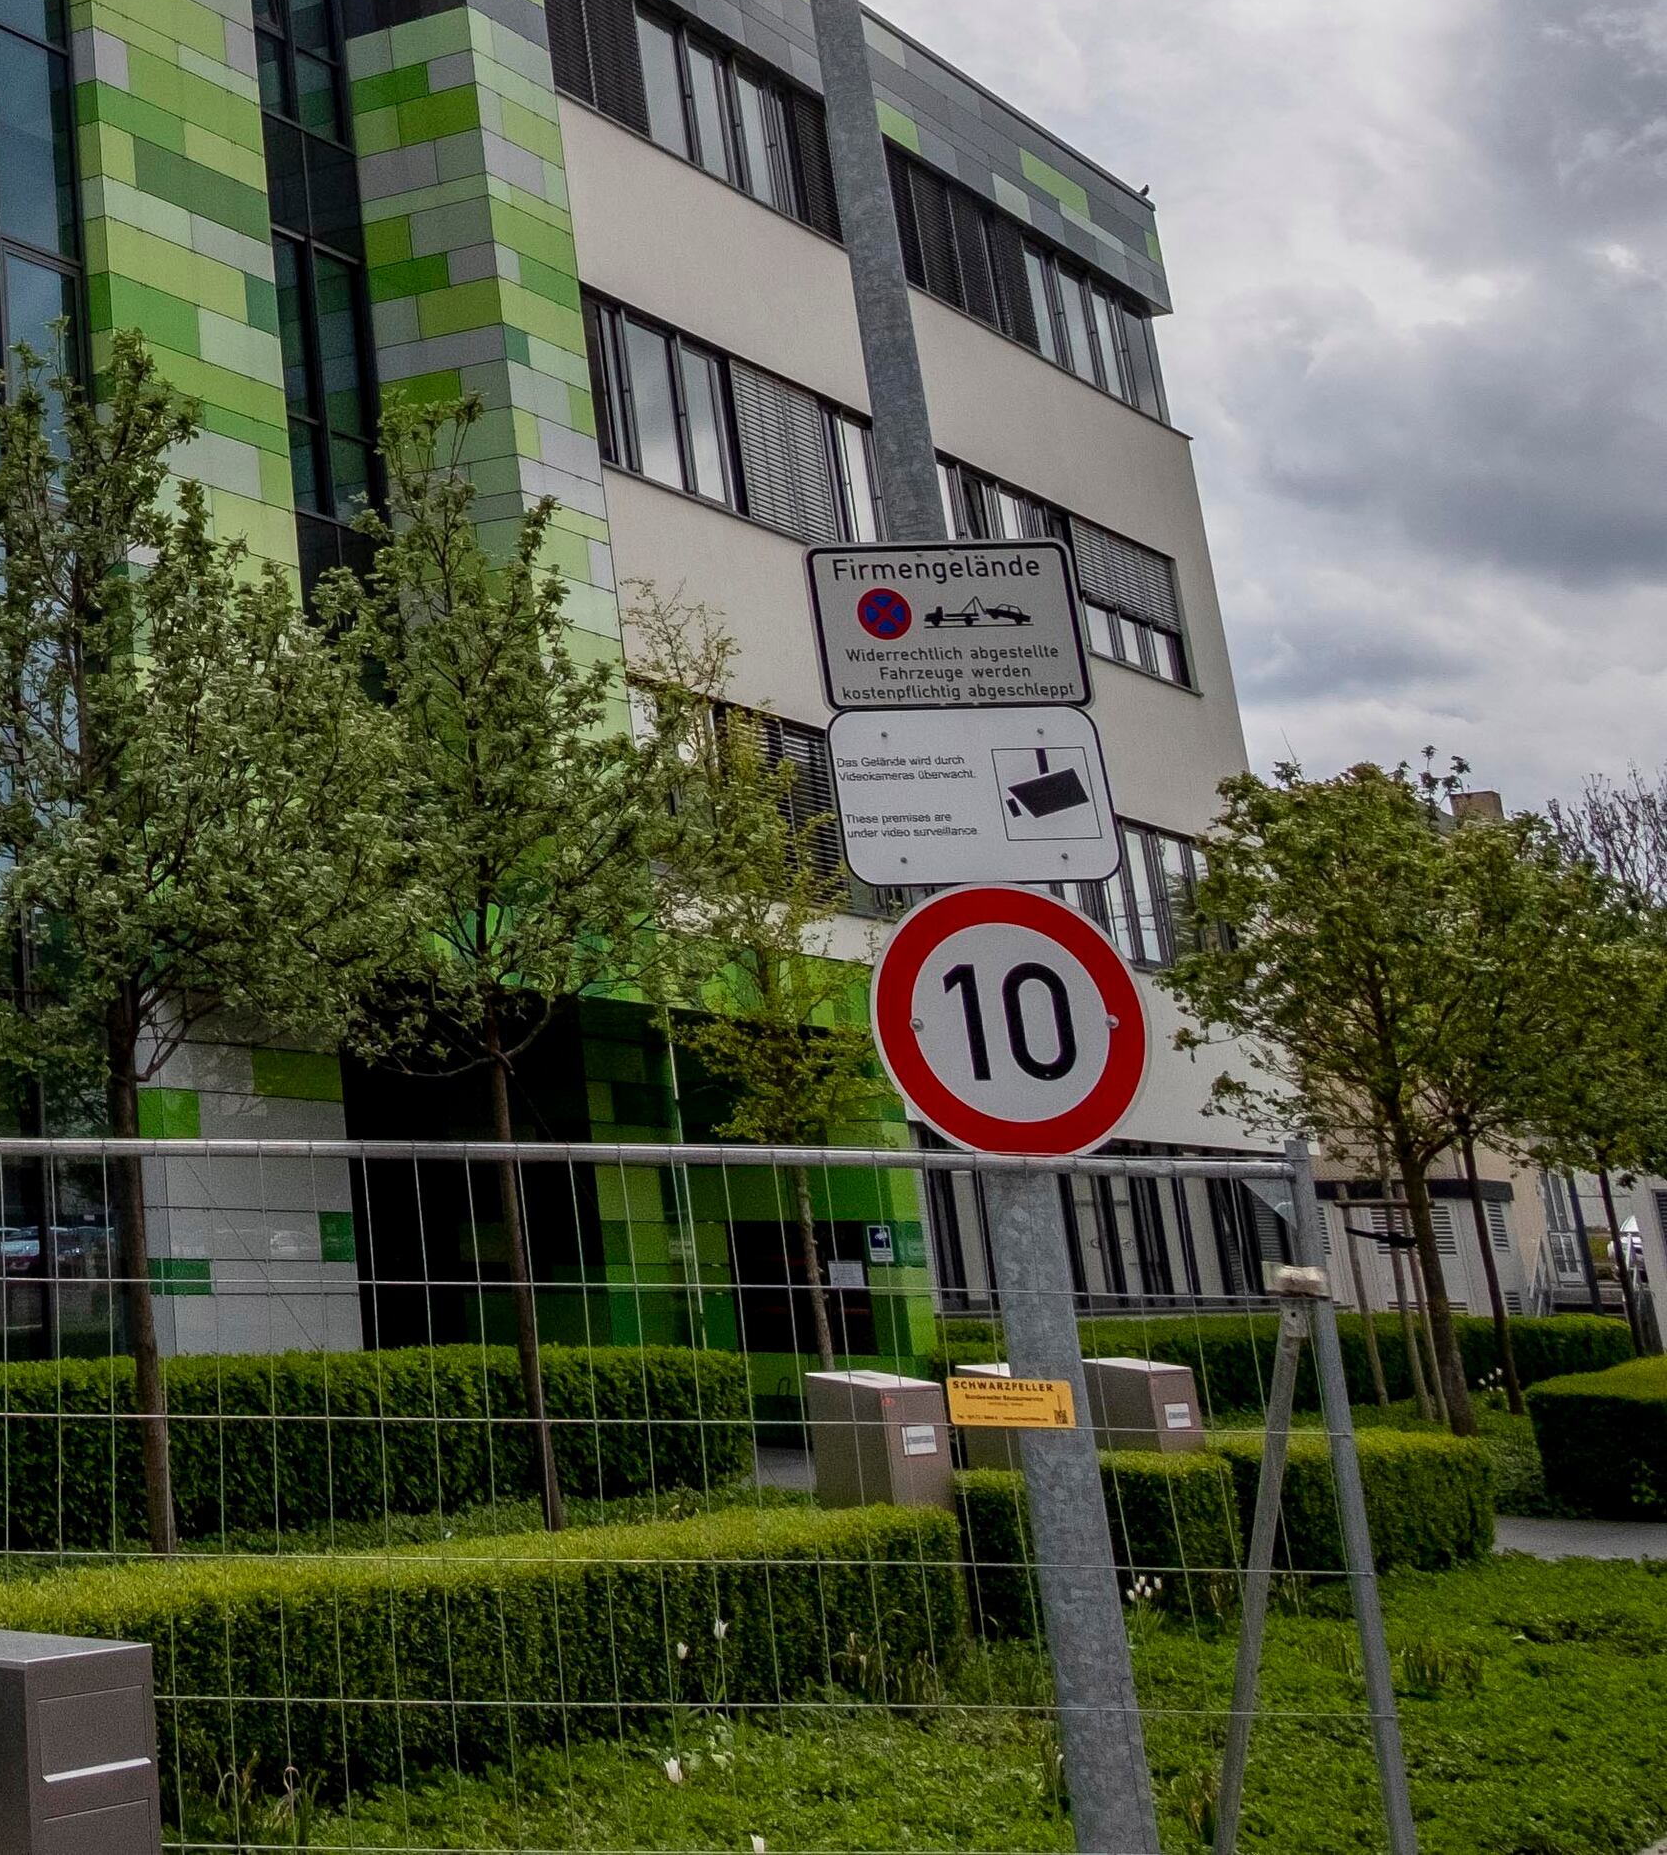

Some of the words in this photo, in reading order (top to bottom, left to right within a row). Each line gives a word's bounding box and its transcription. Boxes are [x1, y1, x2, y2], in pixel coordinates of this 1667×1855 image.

[832, 555, 1040, 584] Firmengelände
[846, 647, 962, 663] Widerrechtlich
[970, 645, 1059, 662] abgestellte
[879, 667, 963, 682] Fahrzeuge
[972, 665, 1031, 677] werden
[842, 684, 960, 701] kostenpflichtig
[968, 682, 1075, 699] abgeschleppt
[836, 757, 858, 768] Das
[908, 755, 931, 765] wird
[934, 755, 965, 765] durch
[846, 814, 878, 824] These
[882, 813, 930, 825] premises
[934, 813, 952, 822] are
[847, 828, 878, 838] under
[881, 827, 910, 837] video
[942, 961, 1077, 1081] 10
[953, 1380, 1054, 1392] SCHWARZFELLER
